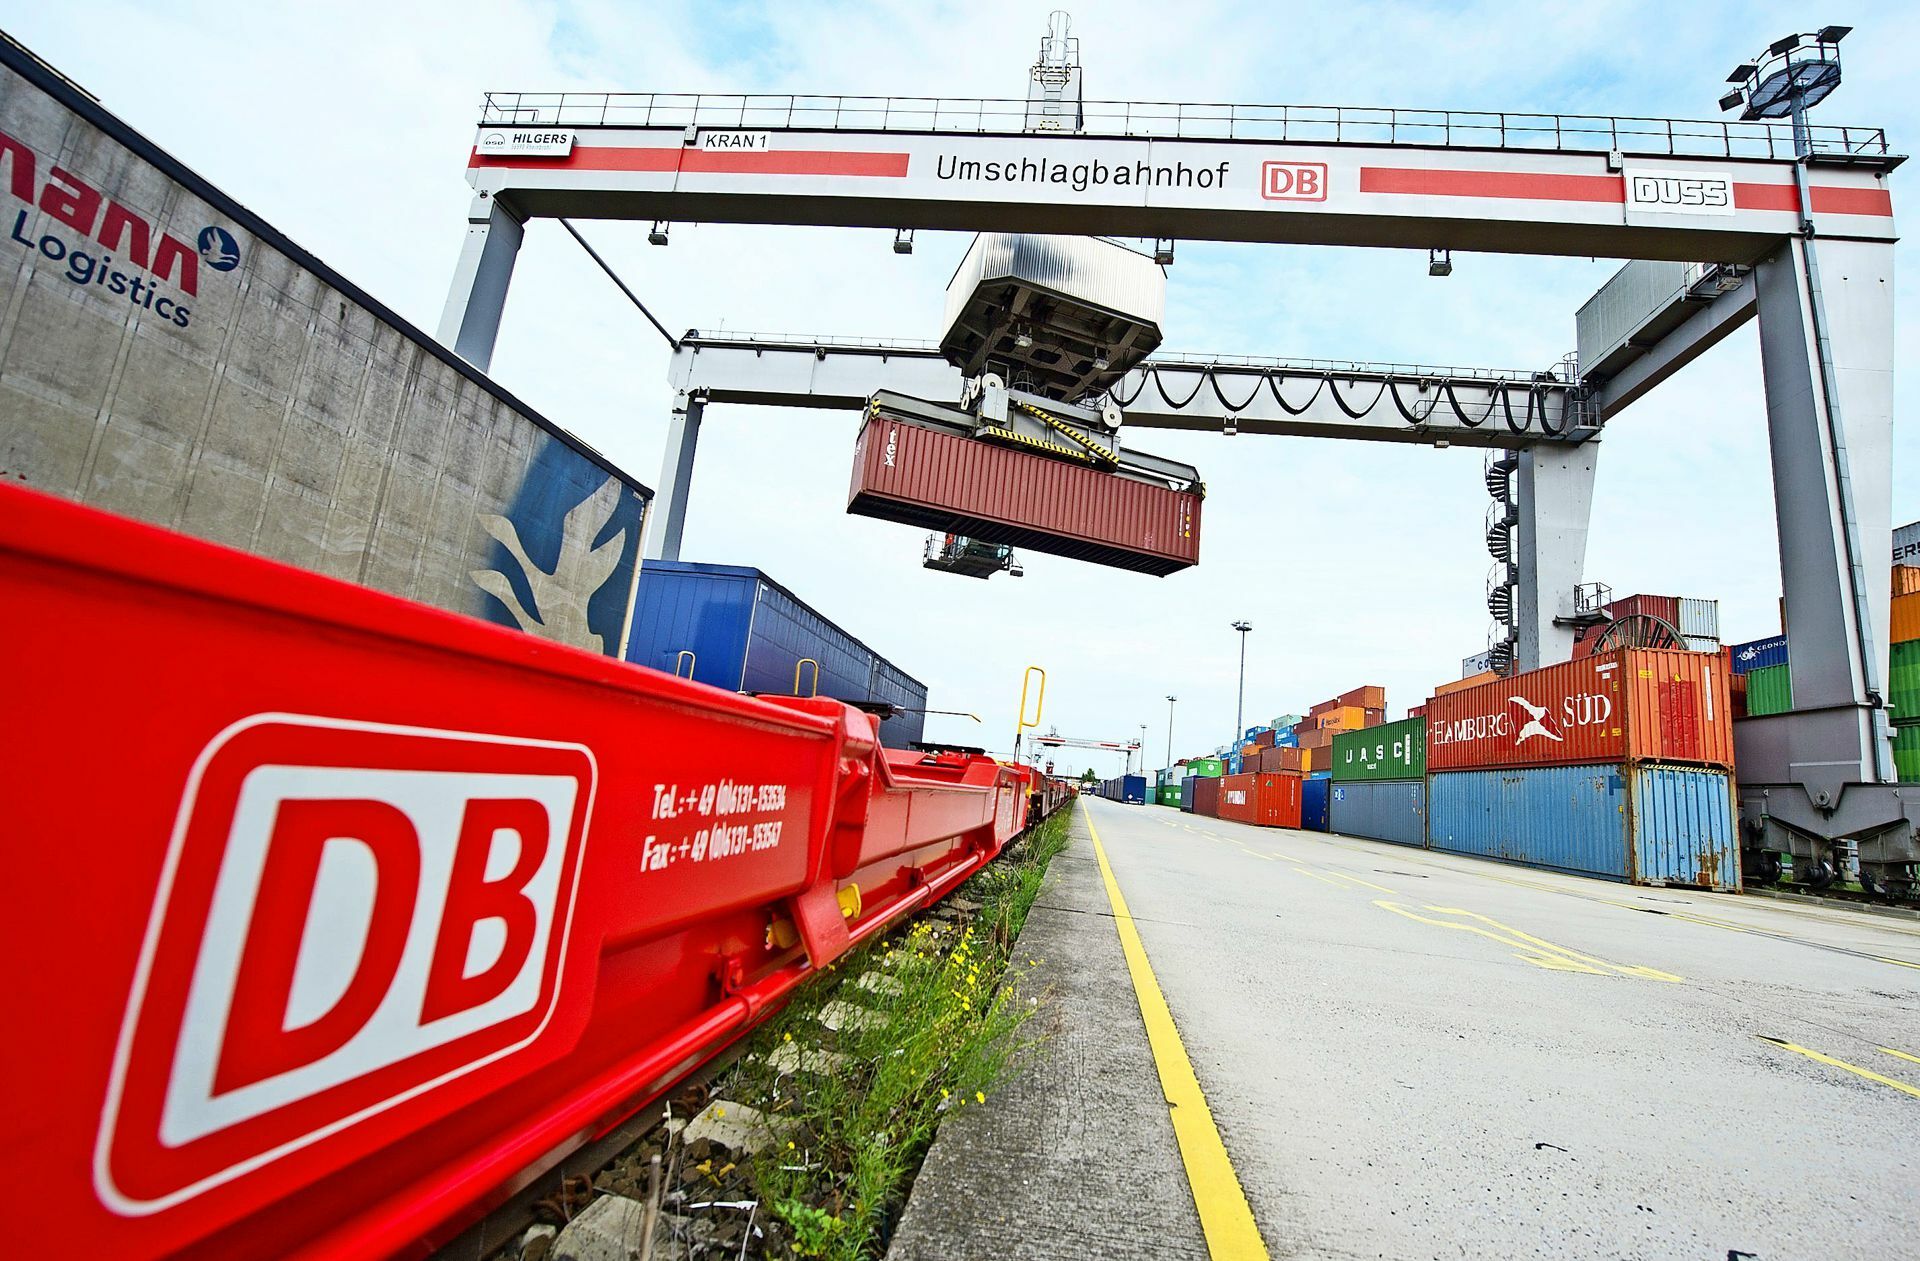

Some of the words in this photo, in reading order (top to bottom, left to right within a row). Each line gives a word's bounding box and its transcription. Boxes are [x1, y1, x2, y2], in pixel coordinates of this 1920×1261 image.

[512, 133, 568, 144] HILGERS
[705, 134, 755, 148] KRAN
[759, 134, 767, 148] 1
[936, 154, 1230, 193] Umschlagbahnhof
[1270, 167, 1319, 195] DB
[1633, 176, 1728, 206] DUSS
[11, 209, 190, 328] Logistics
[884, 429, 897, 468] tex
[1757, 640, 1788, 651] CRONO
[1433, 712, 1509, 745] HAMBURG
[1563, 692, 1611, 728] SÜD
[1345, 741, 1402, 764] UASC
[208, 797, 550, 1100] DB
